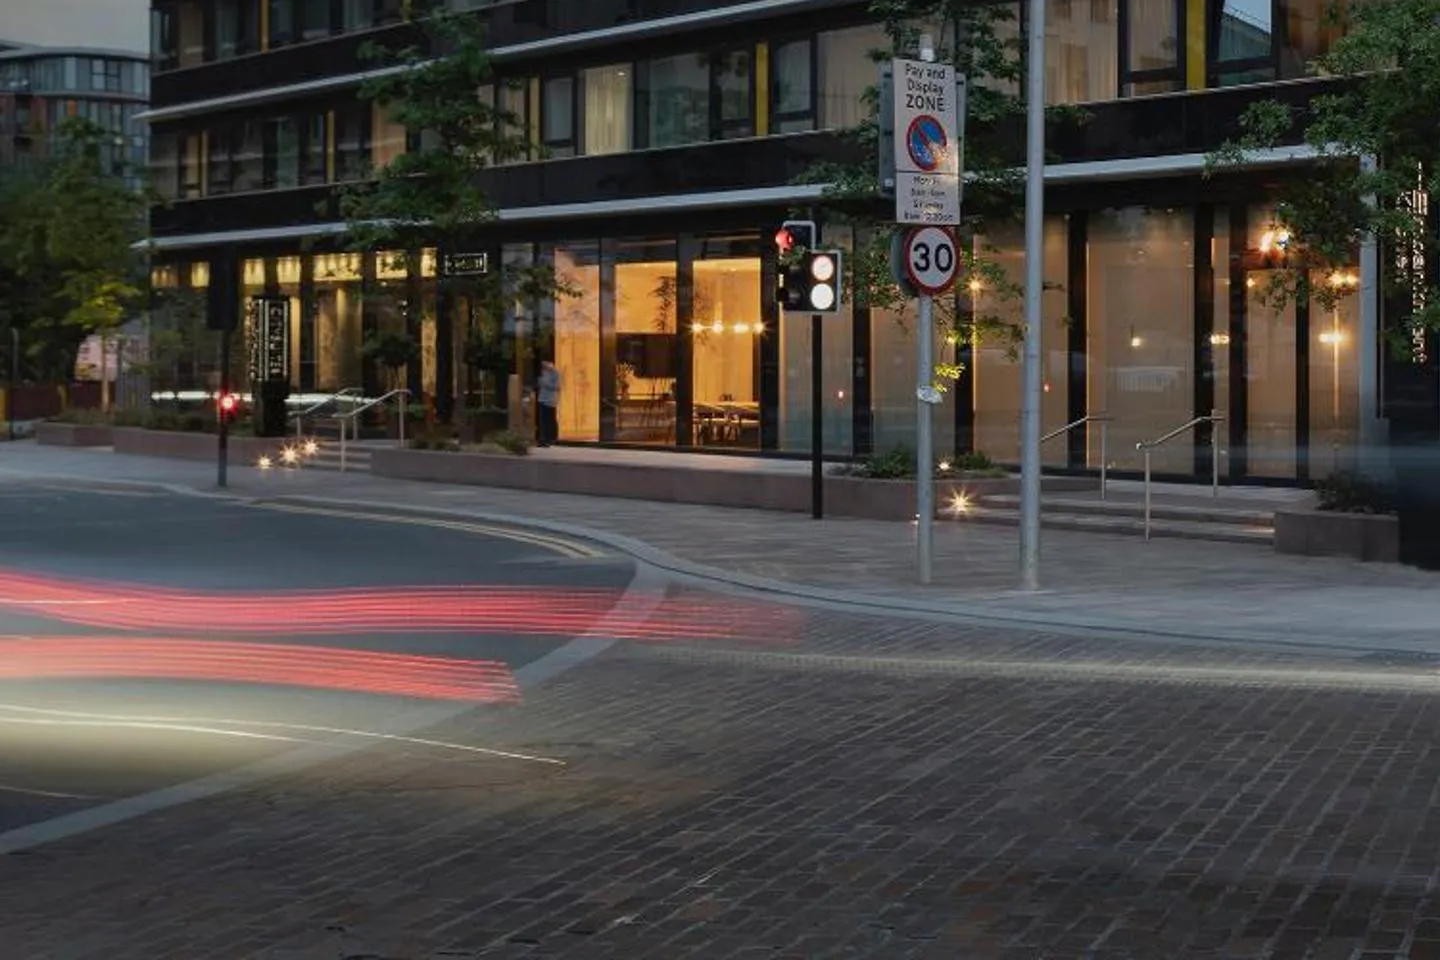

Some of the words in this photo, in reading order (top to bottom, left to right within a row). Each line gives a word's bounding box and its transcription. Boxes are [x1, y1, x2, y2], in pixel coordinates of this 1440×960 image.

[905, 63, 924, 77] Pay
[926, 68, 945, 79] and
[907, 79, 944, 95] Display
[906, 94, 945, 112] ZONE
[913, 242, 953, 273] 30
